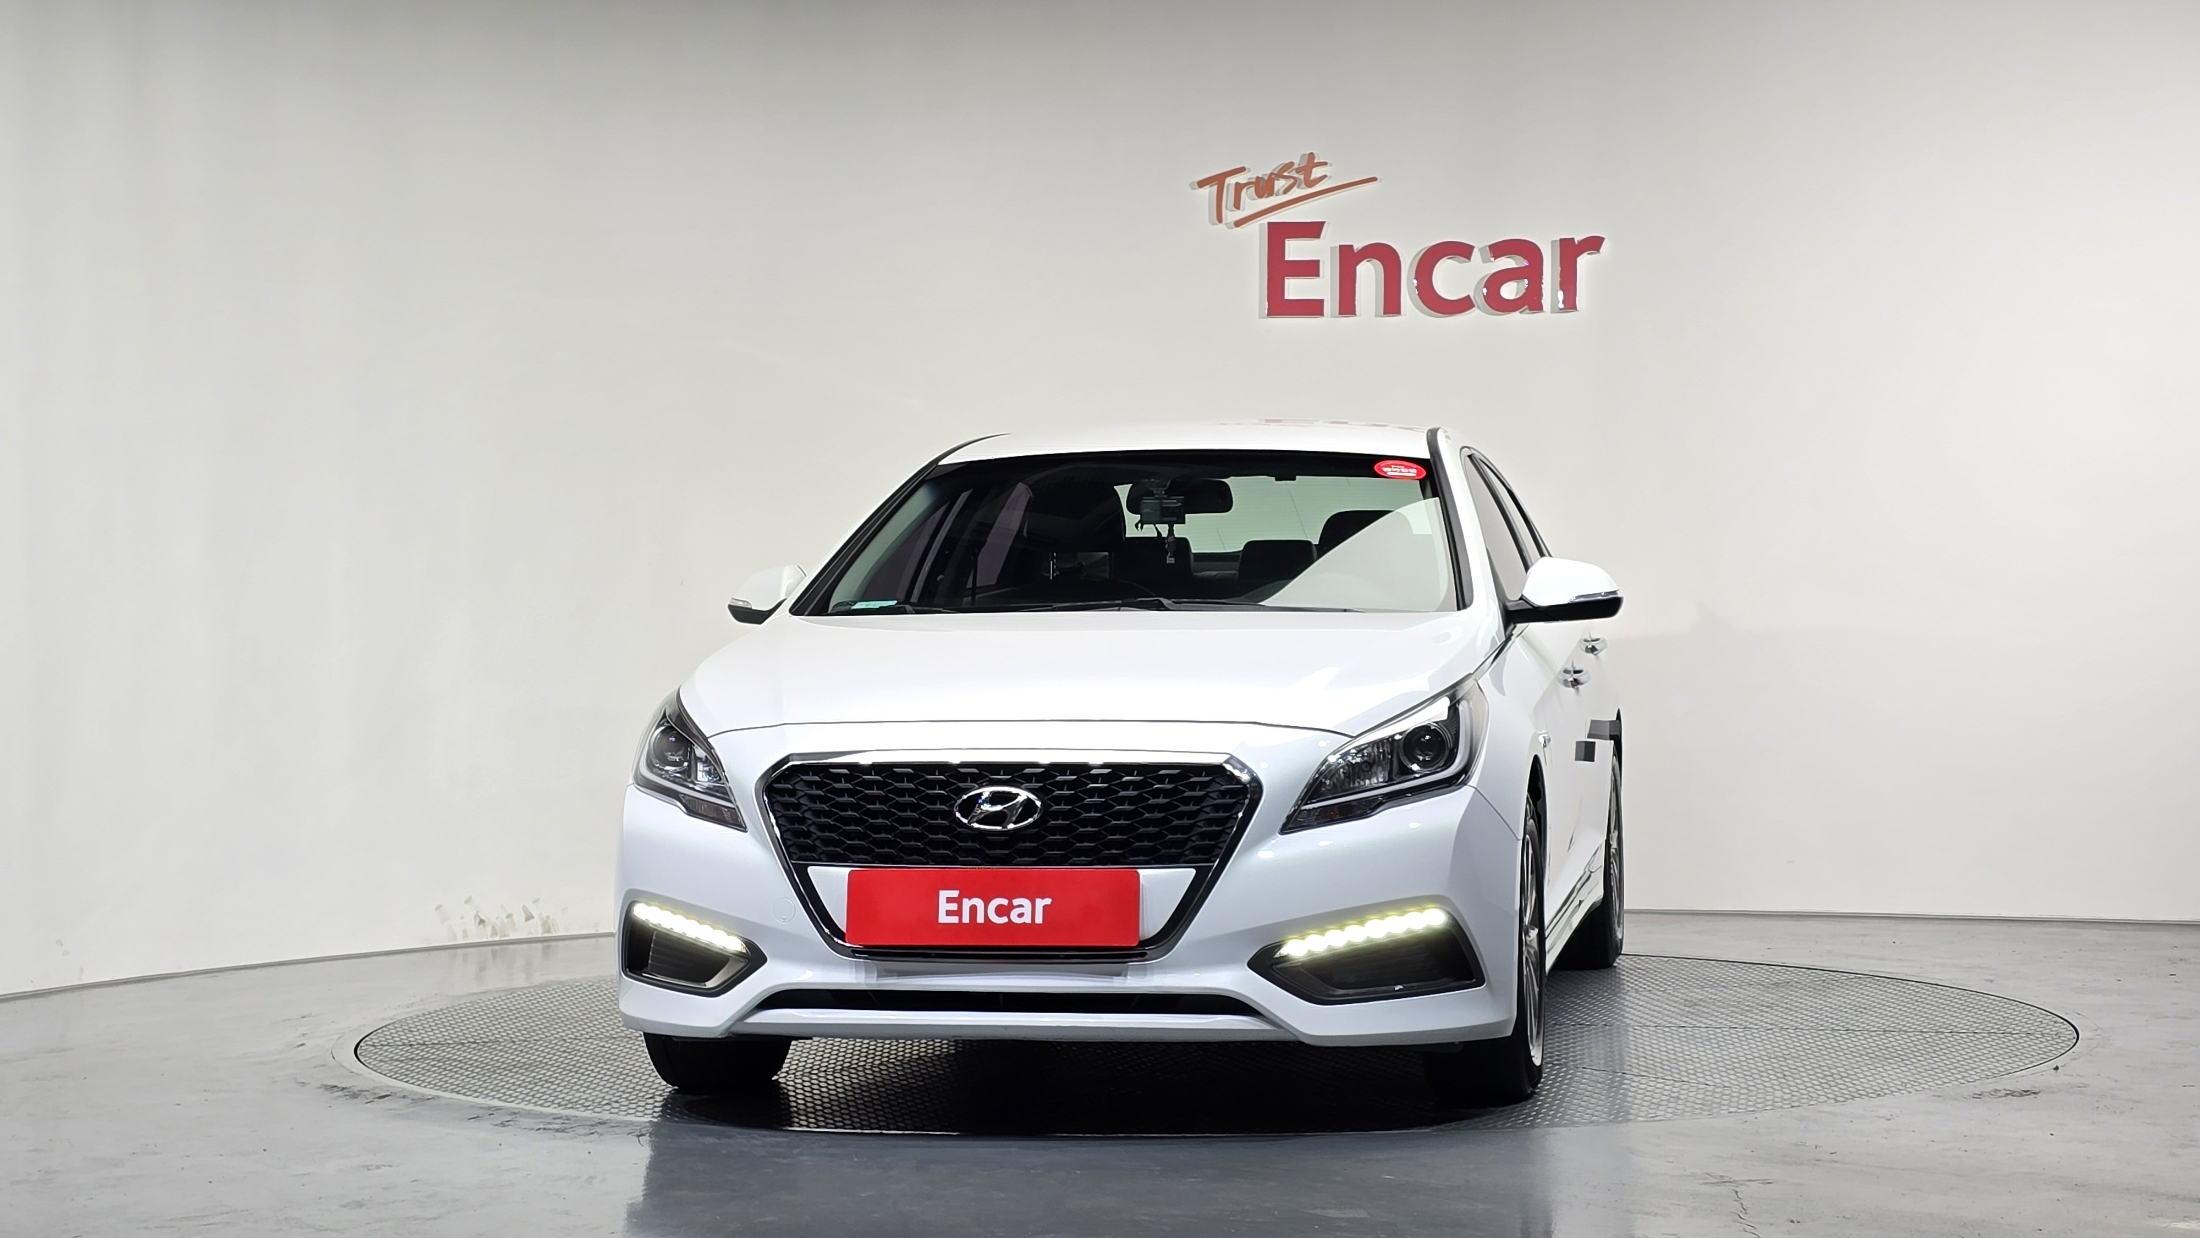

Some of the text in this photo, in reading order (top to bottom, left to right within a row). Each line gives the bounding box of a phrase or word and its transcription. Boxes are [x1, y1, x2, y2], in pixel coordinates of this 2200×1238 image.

[1196, 152, 1329, 224] Trust
[1266, 220, 1606, 317] Encar
[937, 890, 1053, 925] Encar
